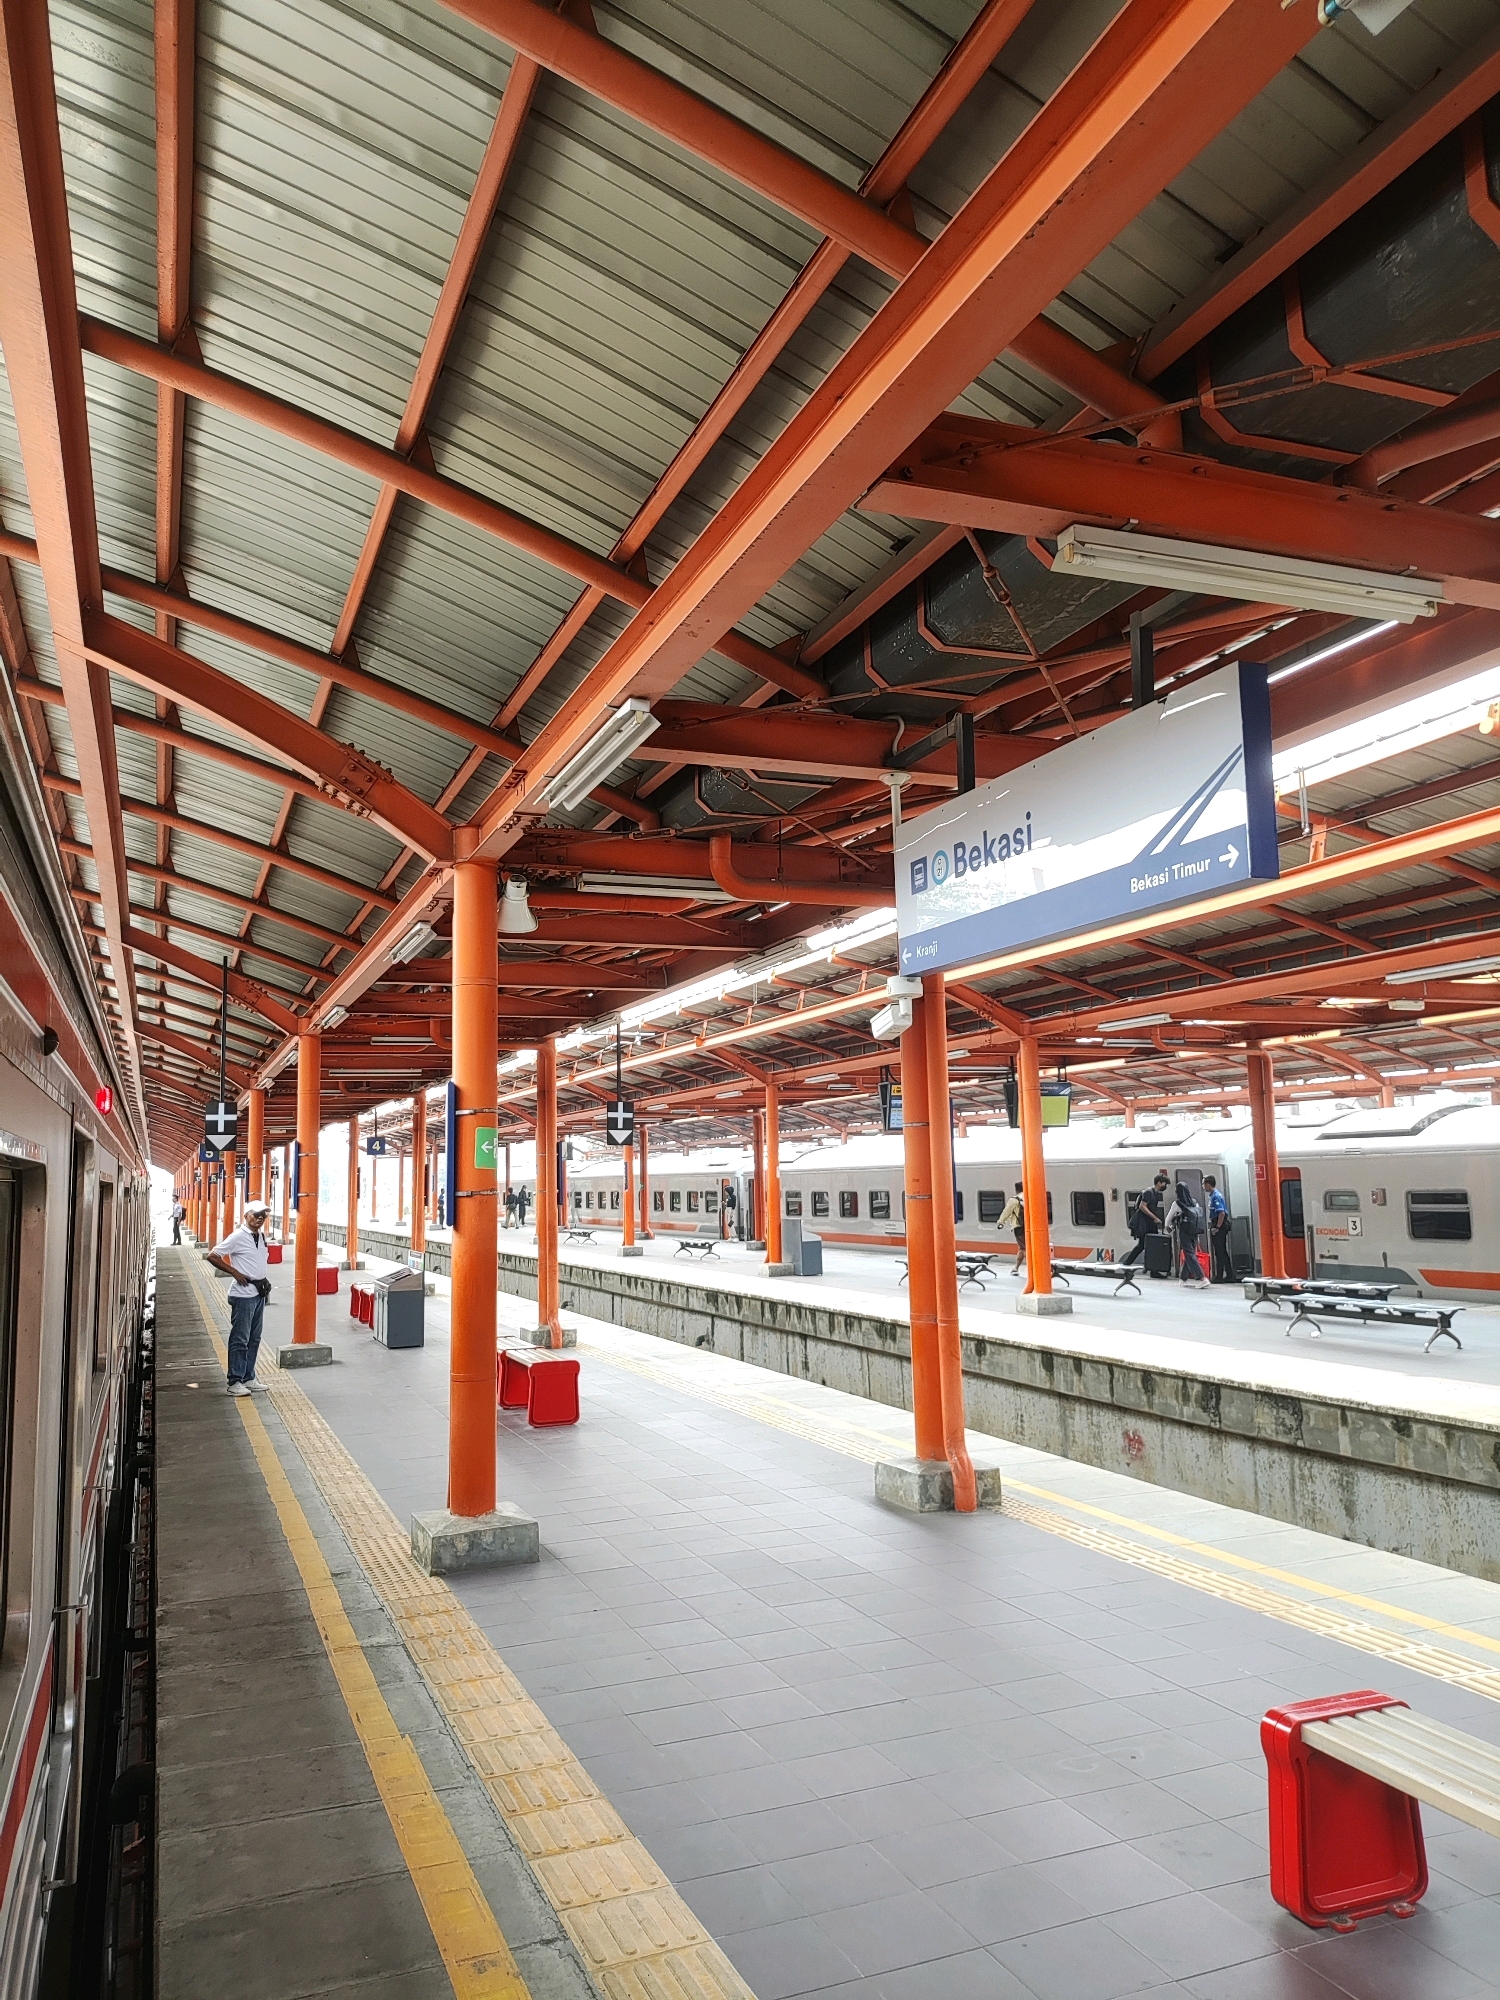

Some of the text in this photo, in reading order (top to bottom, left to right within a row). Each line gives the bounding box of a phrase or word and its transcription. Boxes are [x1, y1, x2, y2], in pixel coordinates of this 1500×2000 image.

[953, 811, 1032, 879] Bekasi
[1130, 858, 1211, 894] Bekasi Timur
[916, 940, 938, 958] Kranji
[372, 1140, 381, 1151] 4
[1316, 1227, 1348, 1236] EKONOMI
[1350, 1220, 1358, 1231] 3
[1096, 1247, 1115, 1262] KAI
